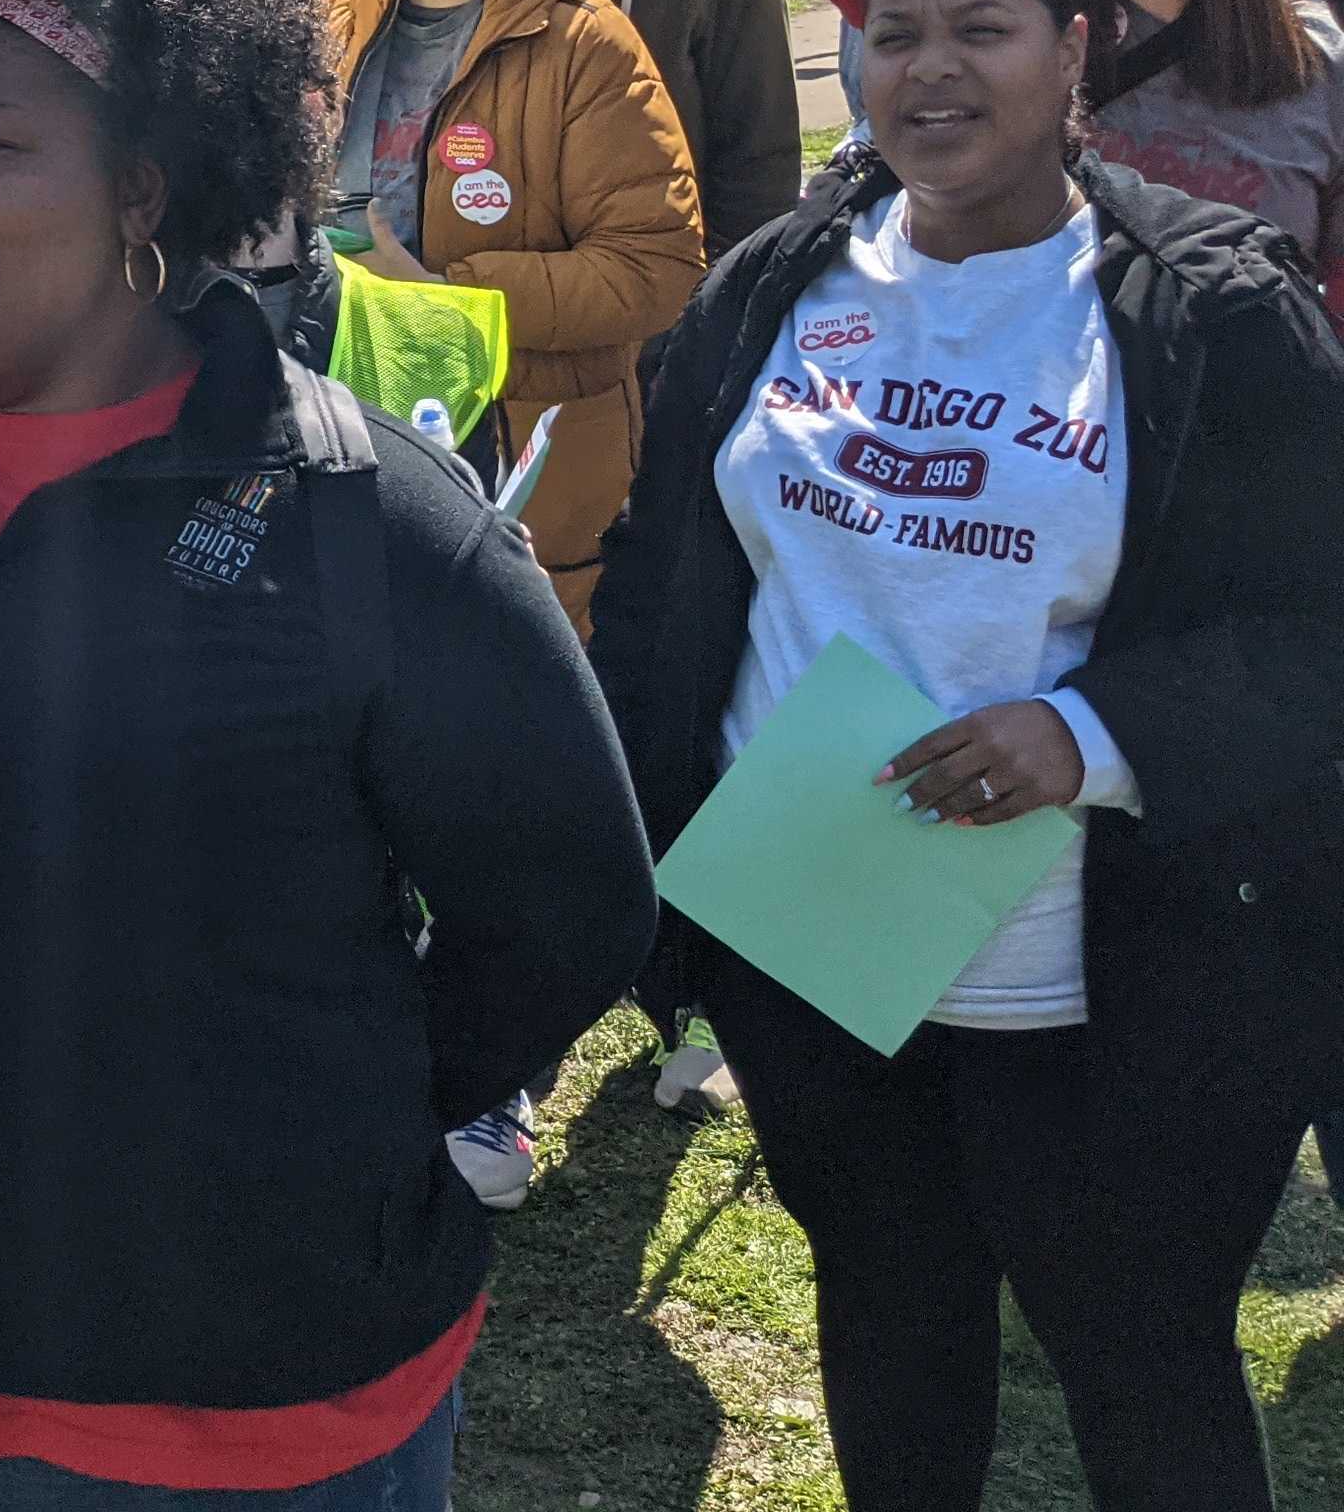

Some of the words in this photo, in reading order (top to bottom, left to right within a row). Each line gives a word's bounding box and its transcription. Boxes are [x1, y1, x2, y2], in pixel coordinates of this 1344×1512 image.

[455, 193, 510, 209] cea
[814, 316, 841, 330] am
[845, 309, 871, 324] the
[764, 376, 863, 413] SAN
[1013, 403, 1108, 474] ZOO
[854, 446, 910, 487] EST.
[921, 459, 970, 488] 1916
[196, 497, 268, 535] EDUCATORS
[178, 520, 255, 567] OHIO'S
[168, 546, 242, 581] FUTURE
